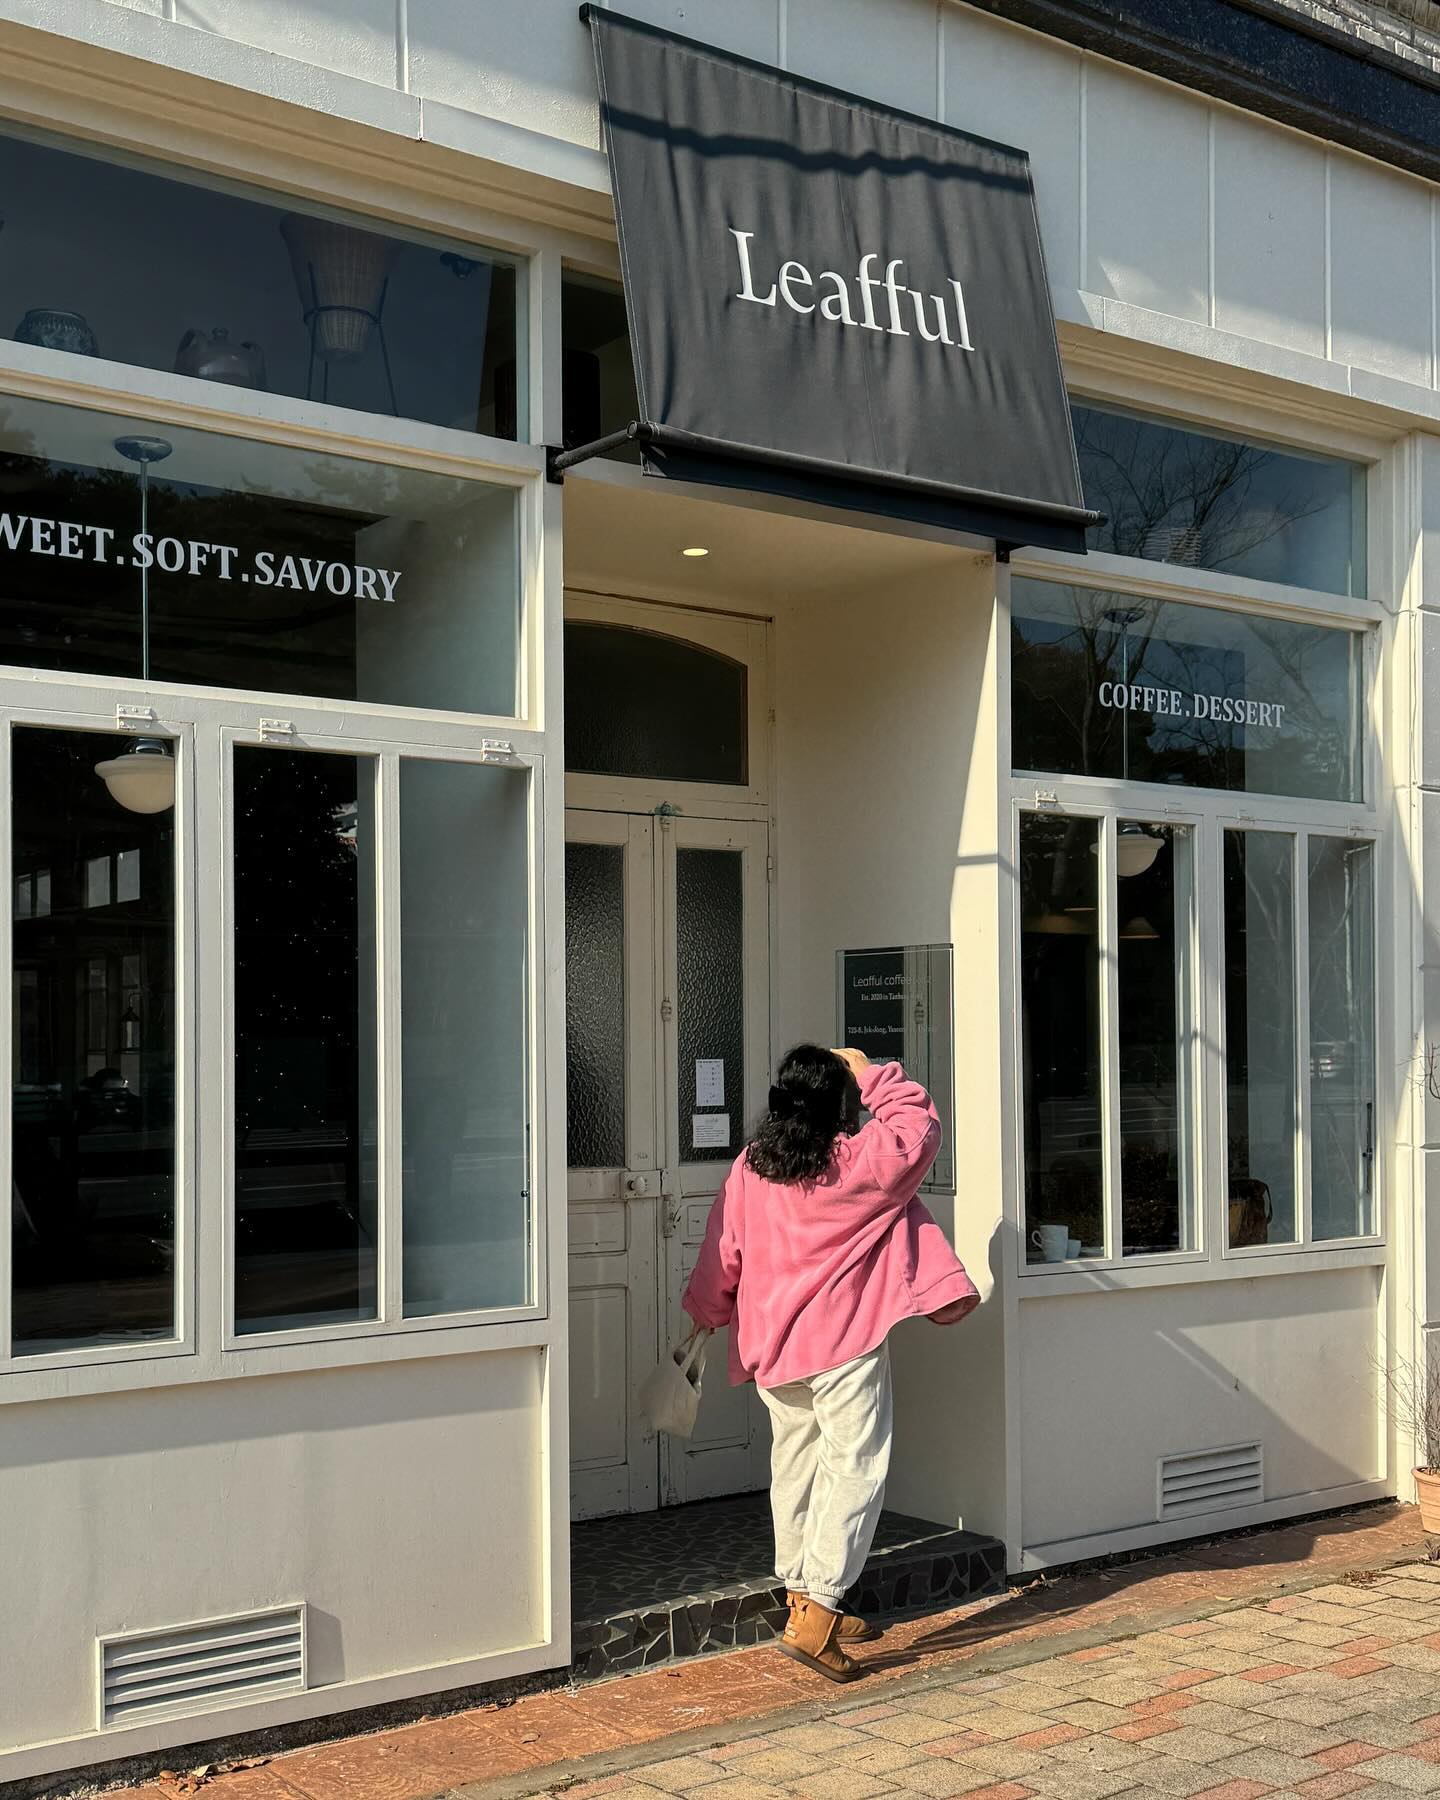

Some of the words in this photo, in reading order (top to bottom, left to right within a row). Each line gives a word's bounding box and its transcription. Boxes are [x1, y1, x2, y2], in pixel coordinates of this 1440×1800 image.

[728, 227, 975, 351] Leafful
[853, 975, 882, 987] Leafful
[884, 974, 912, 985] coffee
